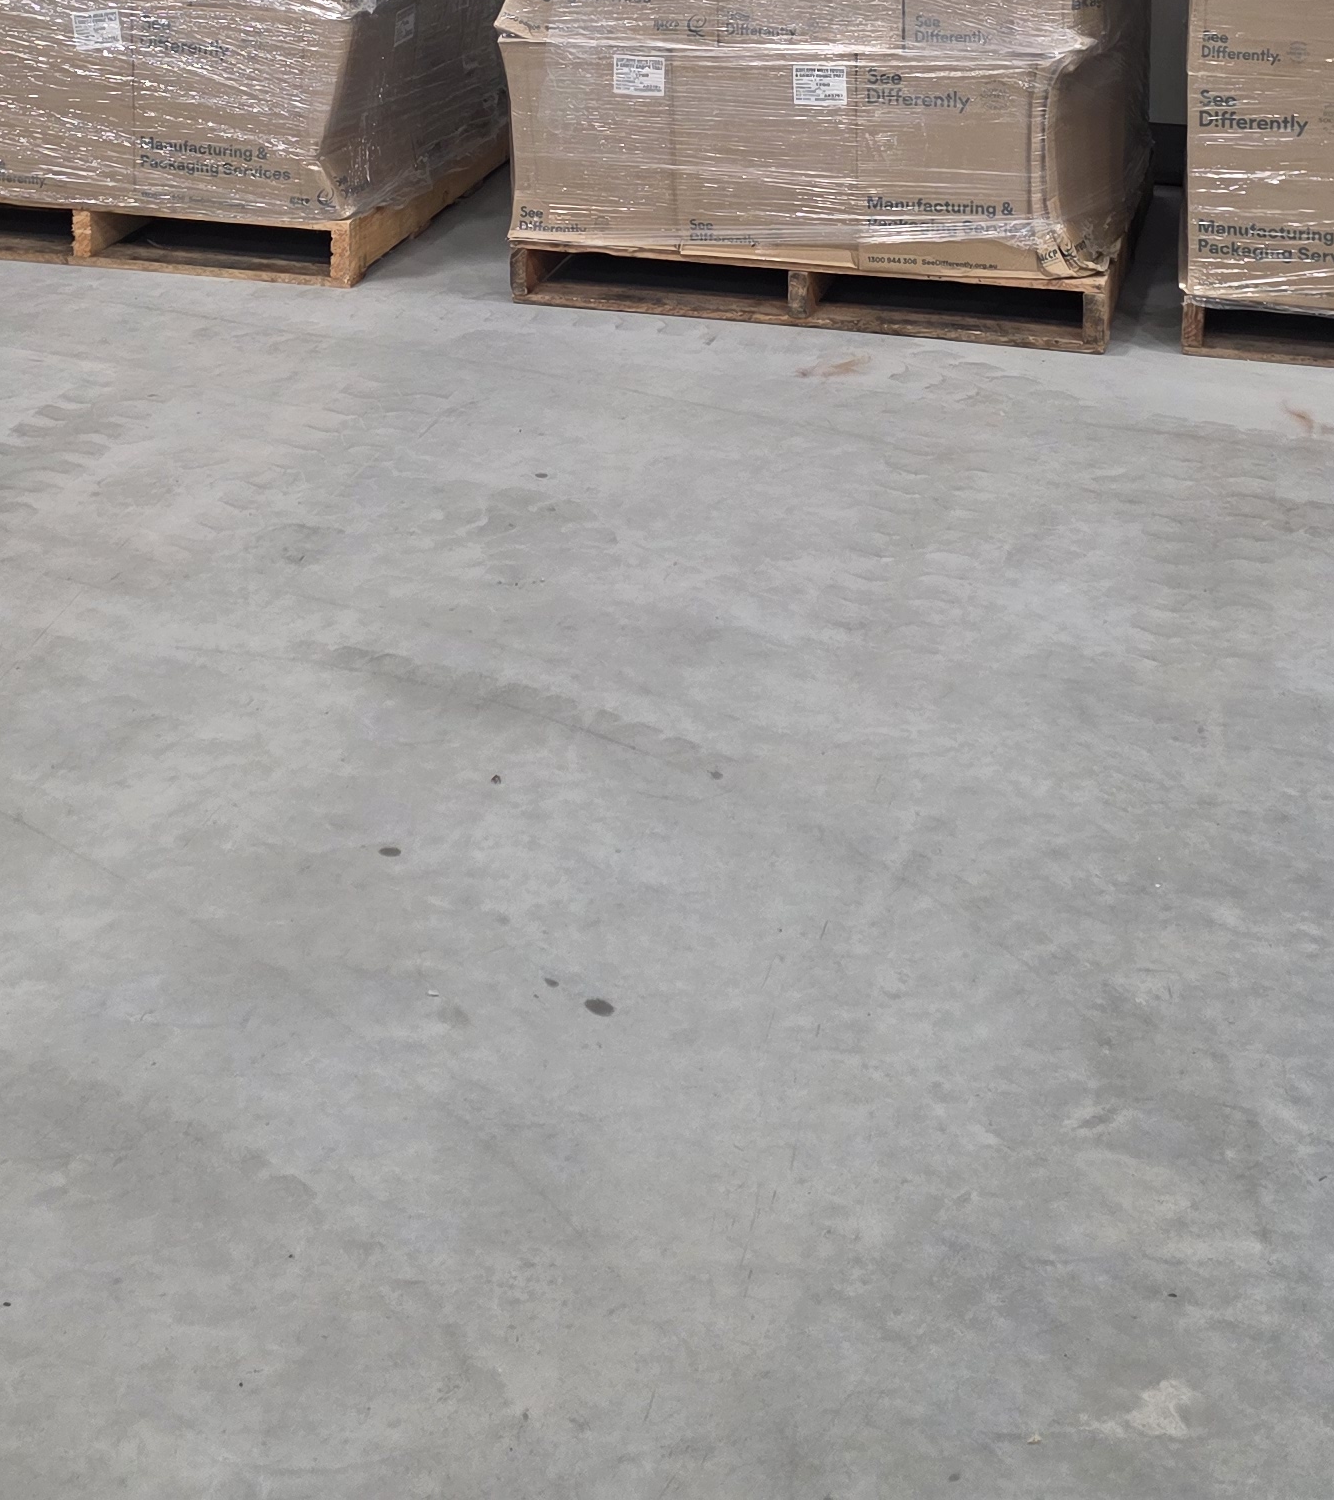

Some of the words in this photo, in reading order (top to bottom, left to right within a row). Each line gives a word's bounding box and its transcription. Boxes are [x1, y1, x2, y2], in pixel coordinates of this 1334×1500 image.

[916, 15, 940, 28] See
[1202, 30, 1229, 43] See
[867, 68, 902, 85] See
[1199, 89, 1237, 107] See
[257, 148, 267, 160] &
[520, 206, 544, 218] See
[867, 196, 997, 218] Manufacturing
[1001, 201, 1014, 216] &
[689, 219, 713, 231] See
[1198, 219, 1334, 245] Manufacturing
[1198, 239, 1292, 263] Packaging
[903, 257, 917, 266] 306
